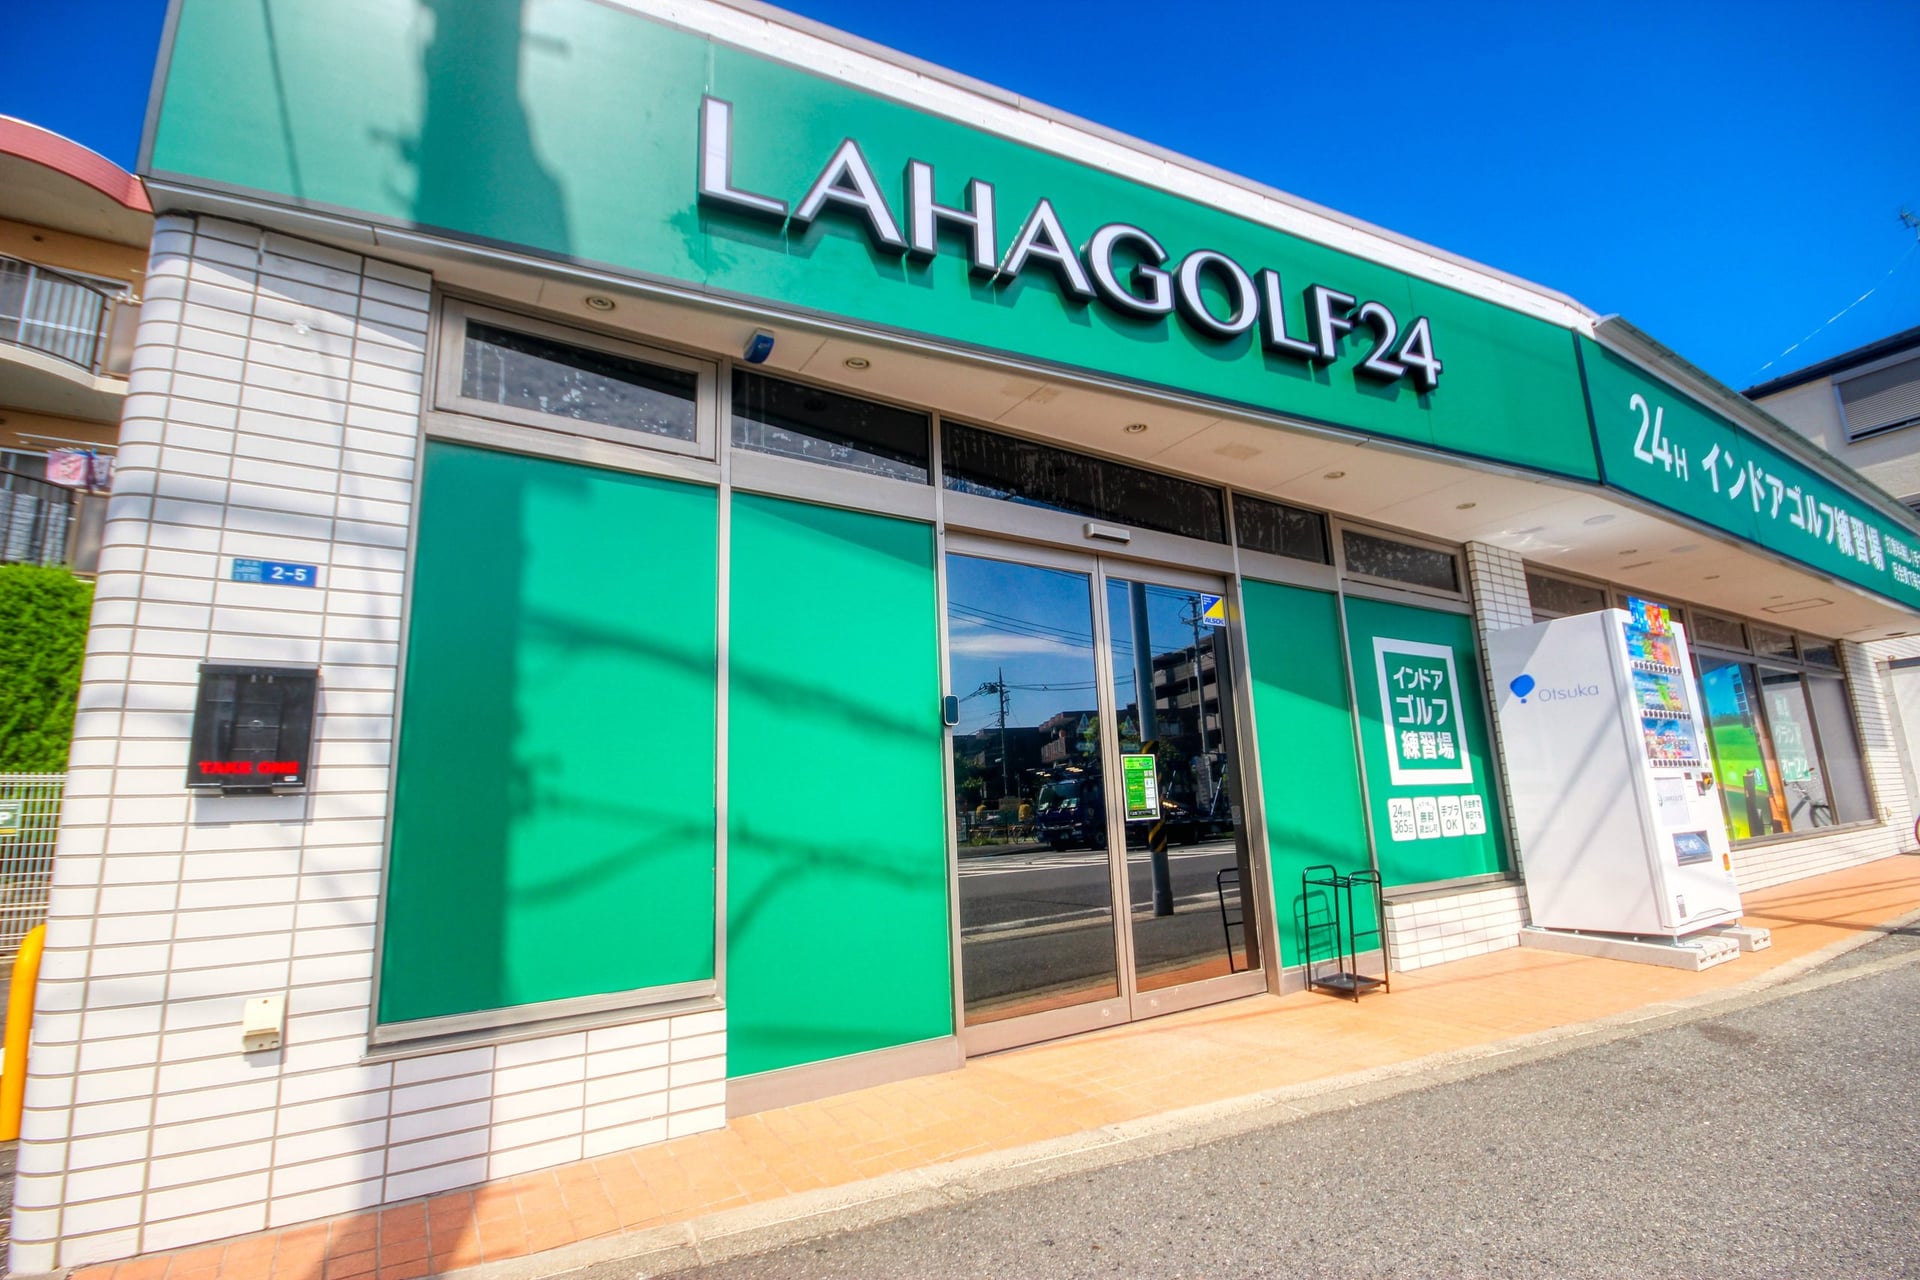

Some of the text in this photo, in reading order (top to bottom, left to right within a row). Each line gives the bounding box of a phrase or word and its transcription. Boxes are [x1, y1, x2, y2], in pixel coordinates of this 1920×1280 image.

[700, 97, 1443, 392] LAHAGOLF24
[1630, 393, 1885, 571] 24H インドアゴルフ練習場
[271, 566, 307, 581] 2-5
[1393, 666, 1443, 691] インドア
[1538, 683, 1599, 702] Otsuka
[1396, 694, 1448, 726] ゴルフ
[1401, 730, 1456, 760] 練習場
[198, 761, 299, 774] TAKE ONE
[1441, 805, 1459, 817] 手ブラ
[1394, 819, 1413, 833] 365日
[1446, 819, 1457, 830] OK
